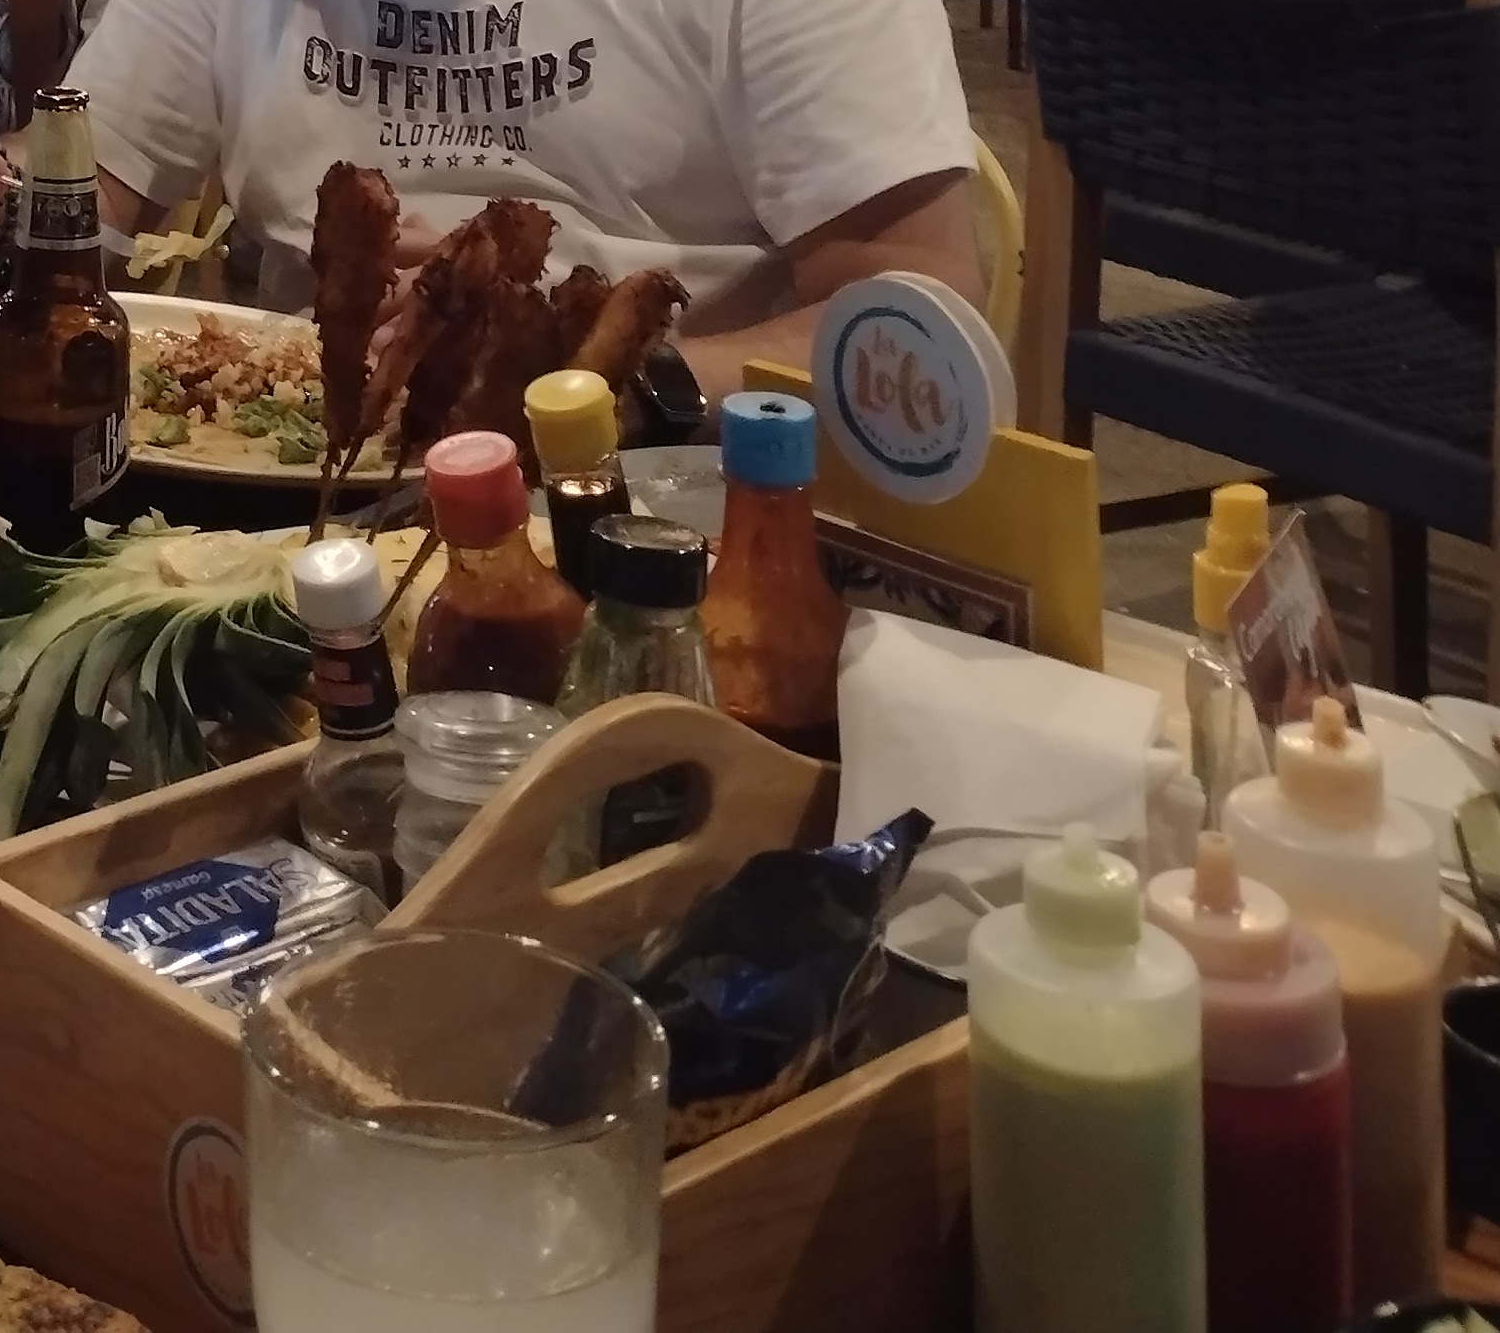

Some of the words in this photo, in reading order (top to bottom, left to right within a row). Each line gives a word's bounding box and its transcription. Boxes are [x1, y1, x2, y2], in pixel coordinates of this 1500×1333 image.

[376, 0, 524, 55] DENIM
[303, 36, 594, 114] OUTFITTERS
[378, 122, 494, 148] CLOTHING
[503, 125, 533, 152] CO.
[140, 870, 212, 902] Gamesa
